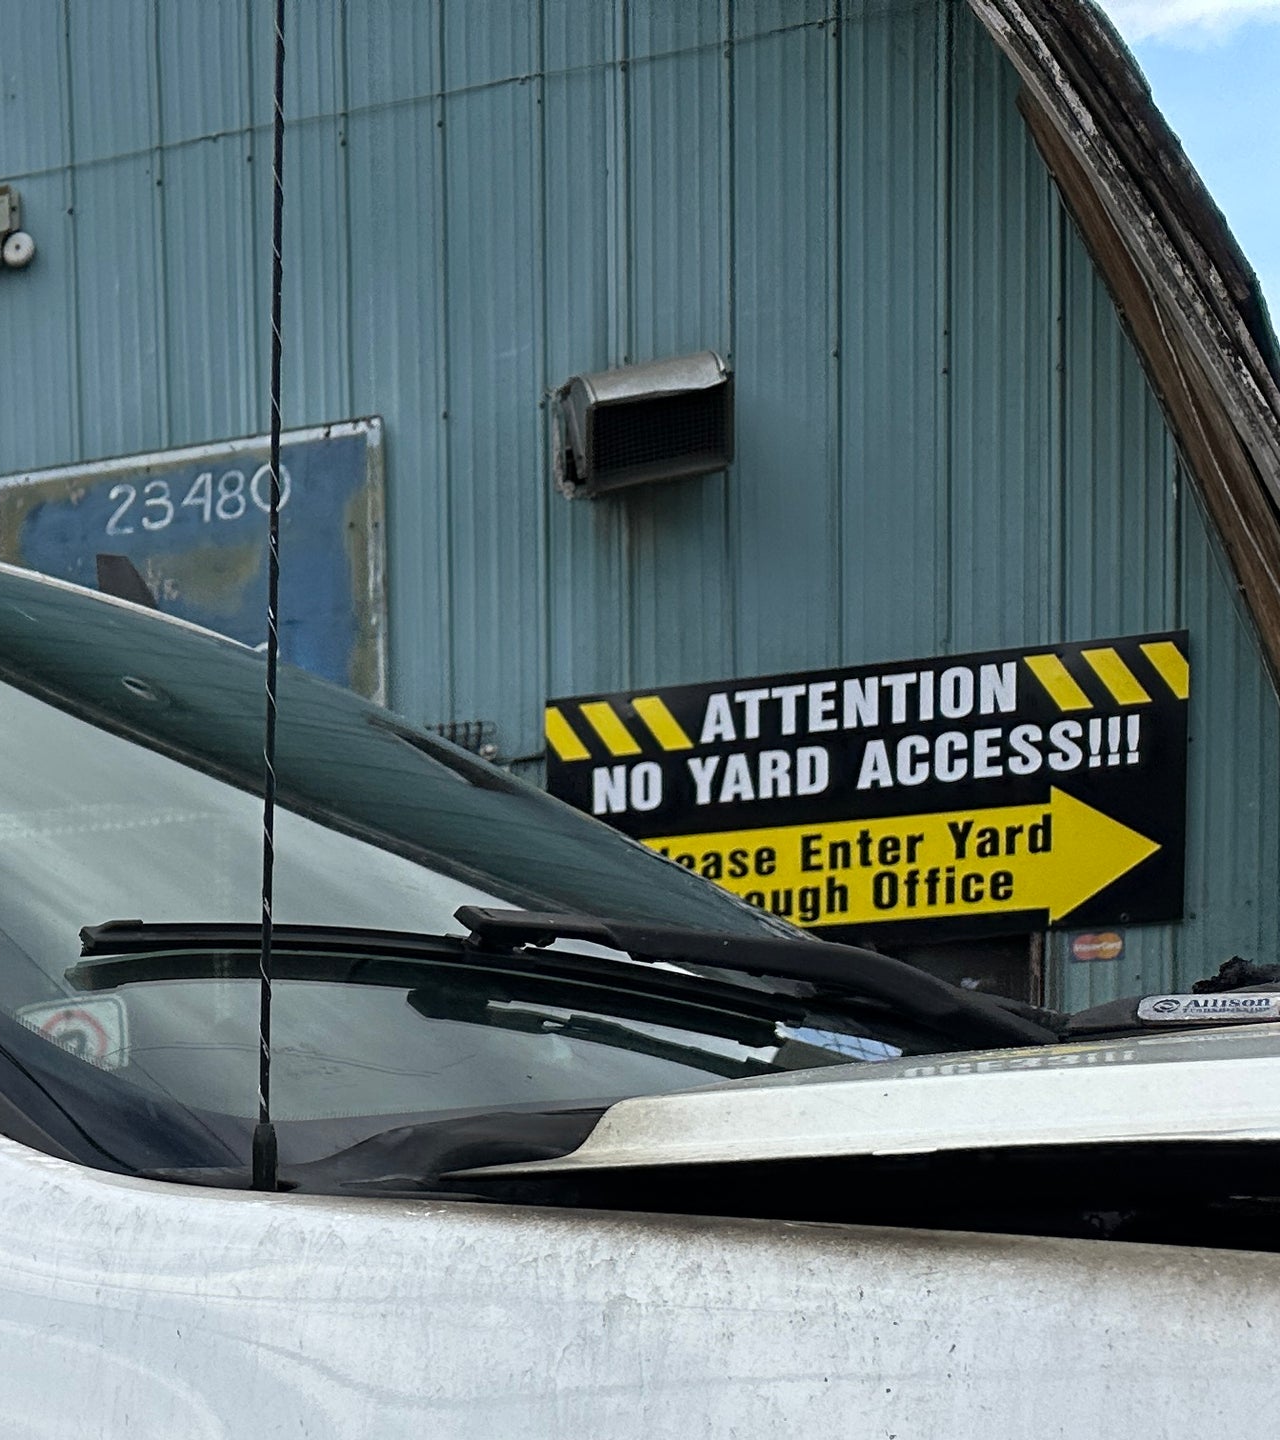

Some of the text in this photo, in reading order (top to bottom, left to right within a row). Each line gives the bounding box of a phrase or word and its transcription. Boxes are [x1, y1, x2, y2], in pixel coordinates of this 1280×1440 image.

[105, 462, 292, 536] 23480
[700, 661, 1018, 744] ATTENTION
[592, 714, 1141, 815] NO YARD ACCESS!!!
[659, 813, 1053, 881] ease Enter Yard
[872, 865, 1015, 911] Office
